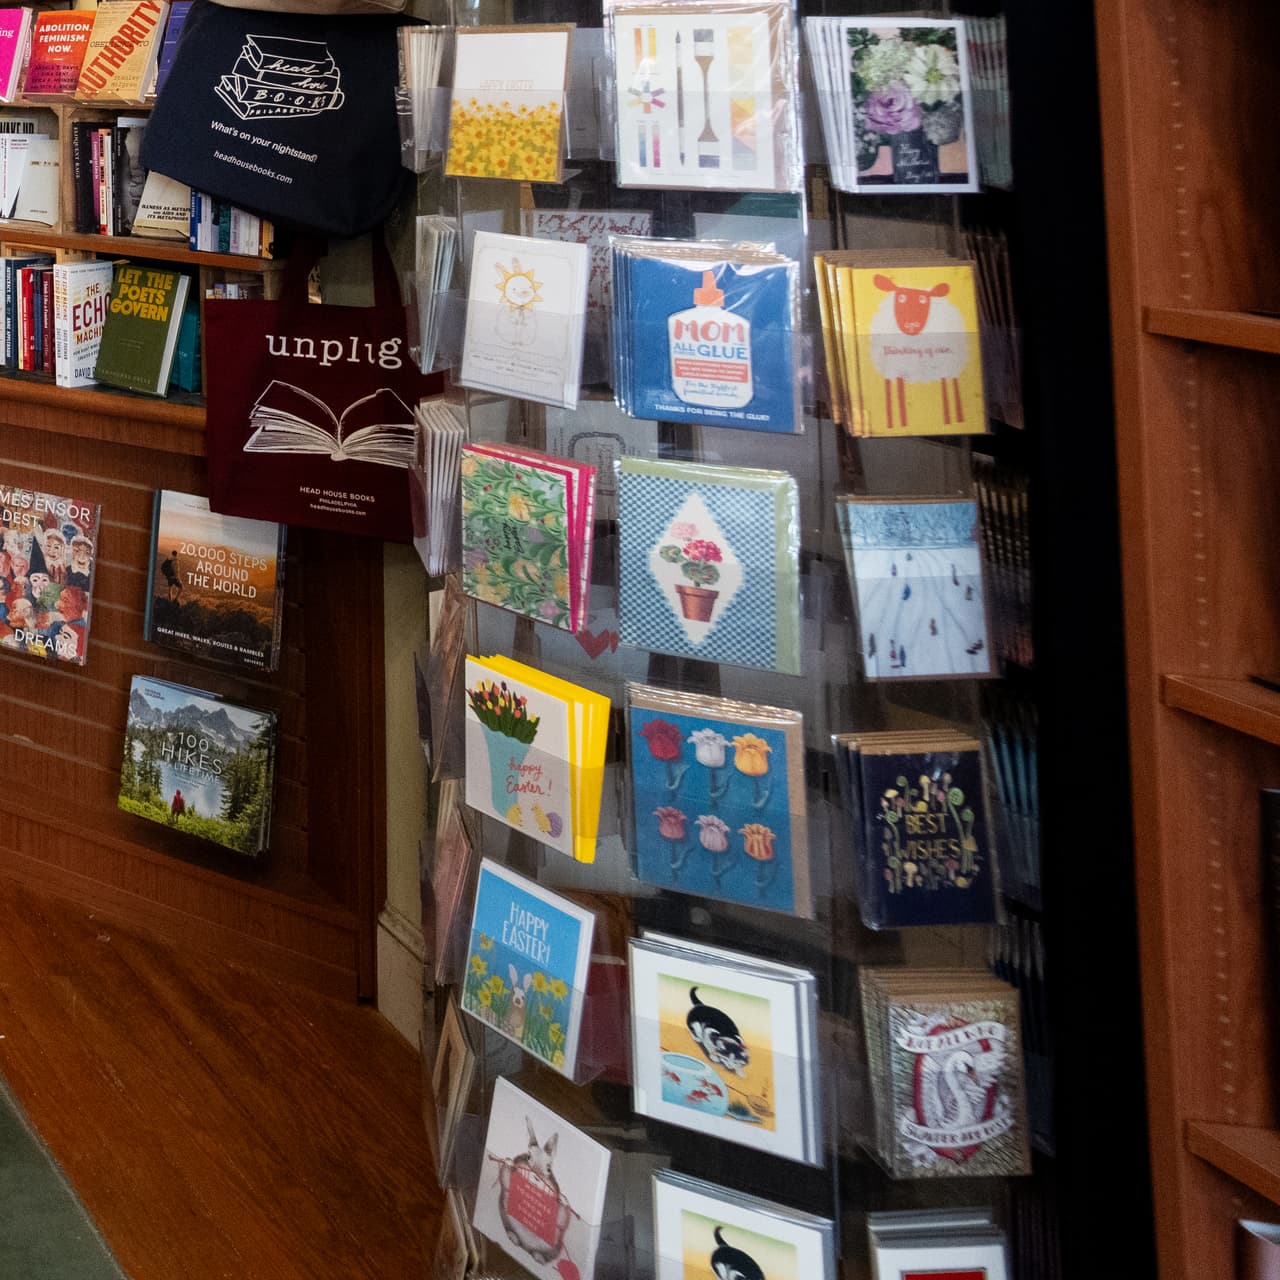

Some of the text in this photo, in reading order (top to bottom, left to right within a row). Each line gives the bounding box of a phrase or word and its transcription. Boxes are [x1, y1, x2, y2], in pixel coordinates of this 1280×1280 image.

[39, 23, 92, 33] ABOLITION.
[39, 34, 88, 43] FEMINISM.
[48, 45, 73, 53] NOW.
[79, 0, 162, 99] AUTHORITY
[211, 120, 318, 164] What's on your nightstand?
[213, 150, 293, 184] headhousebooks.com
[86, 282, 100, 295] THE
[117, 270, 174, 289] LET THE
[119, 286, 166, 304] POETS
[110, 299, 169, 322] GOVERN
[674, 319, 745, 343] MOM
[673, 342, 749, 360] ALL GLUE
[300, 487, 375, 503] HEAD HOUSE BOOKS
[319, 498, 357, 507] PHILADELPHIA
[35, 497, 91, 522] ENSOR
[179, 542, 268, 572] 20,000 STEPS
[195, 561, 249, 582] AROUND
[186, 572, 257, 599] THE WORLD
[14, 628, 78, 657] DREAMS
[178, 731, 209, 754] 100
[161, 742, 223, 776] HIKES
[509, 757, 543, 781] happy
[904, 812, 949, 835] BEST
[899, 838, 961, 860] WISHES
[510, 902, 549, 940] HAPPY
[502, 920, 551, 967] EASTER!
